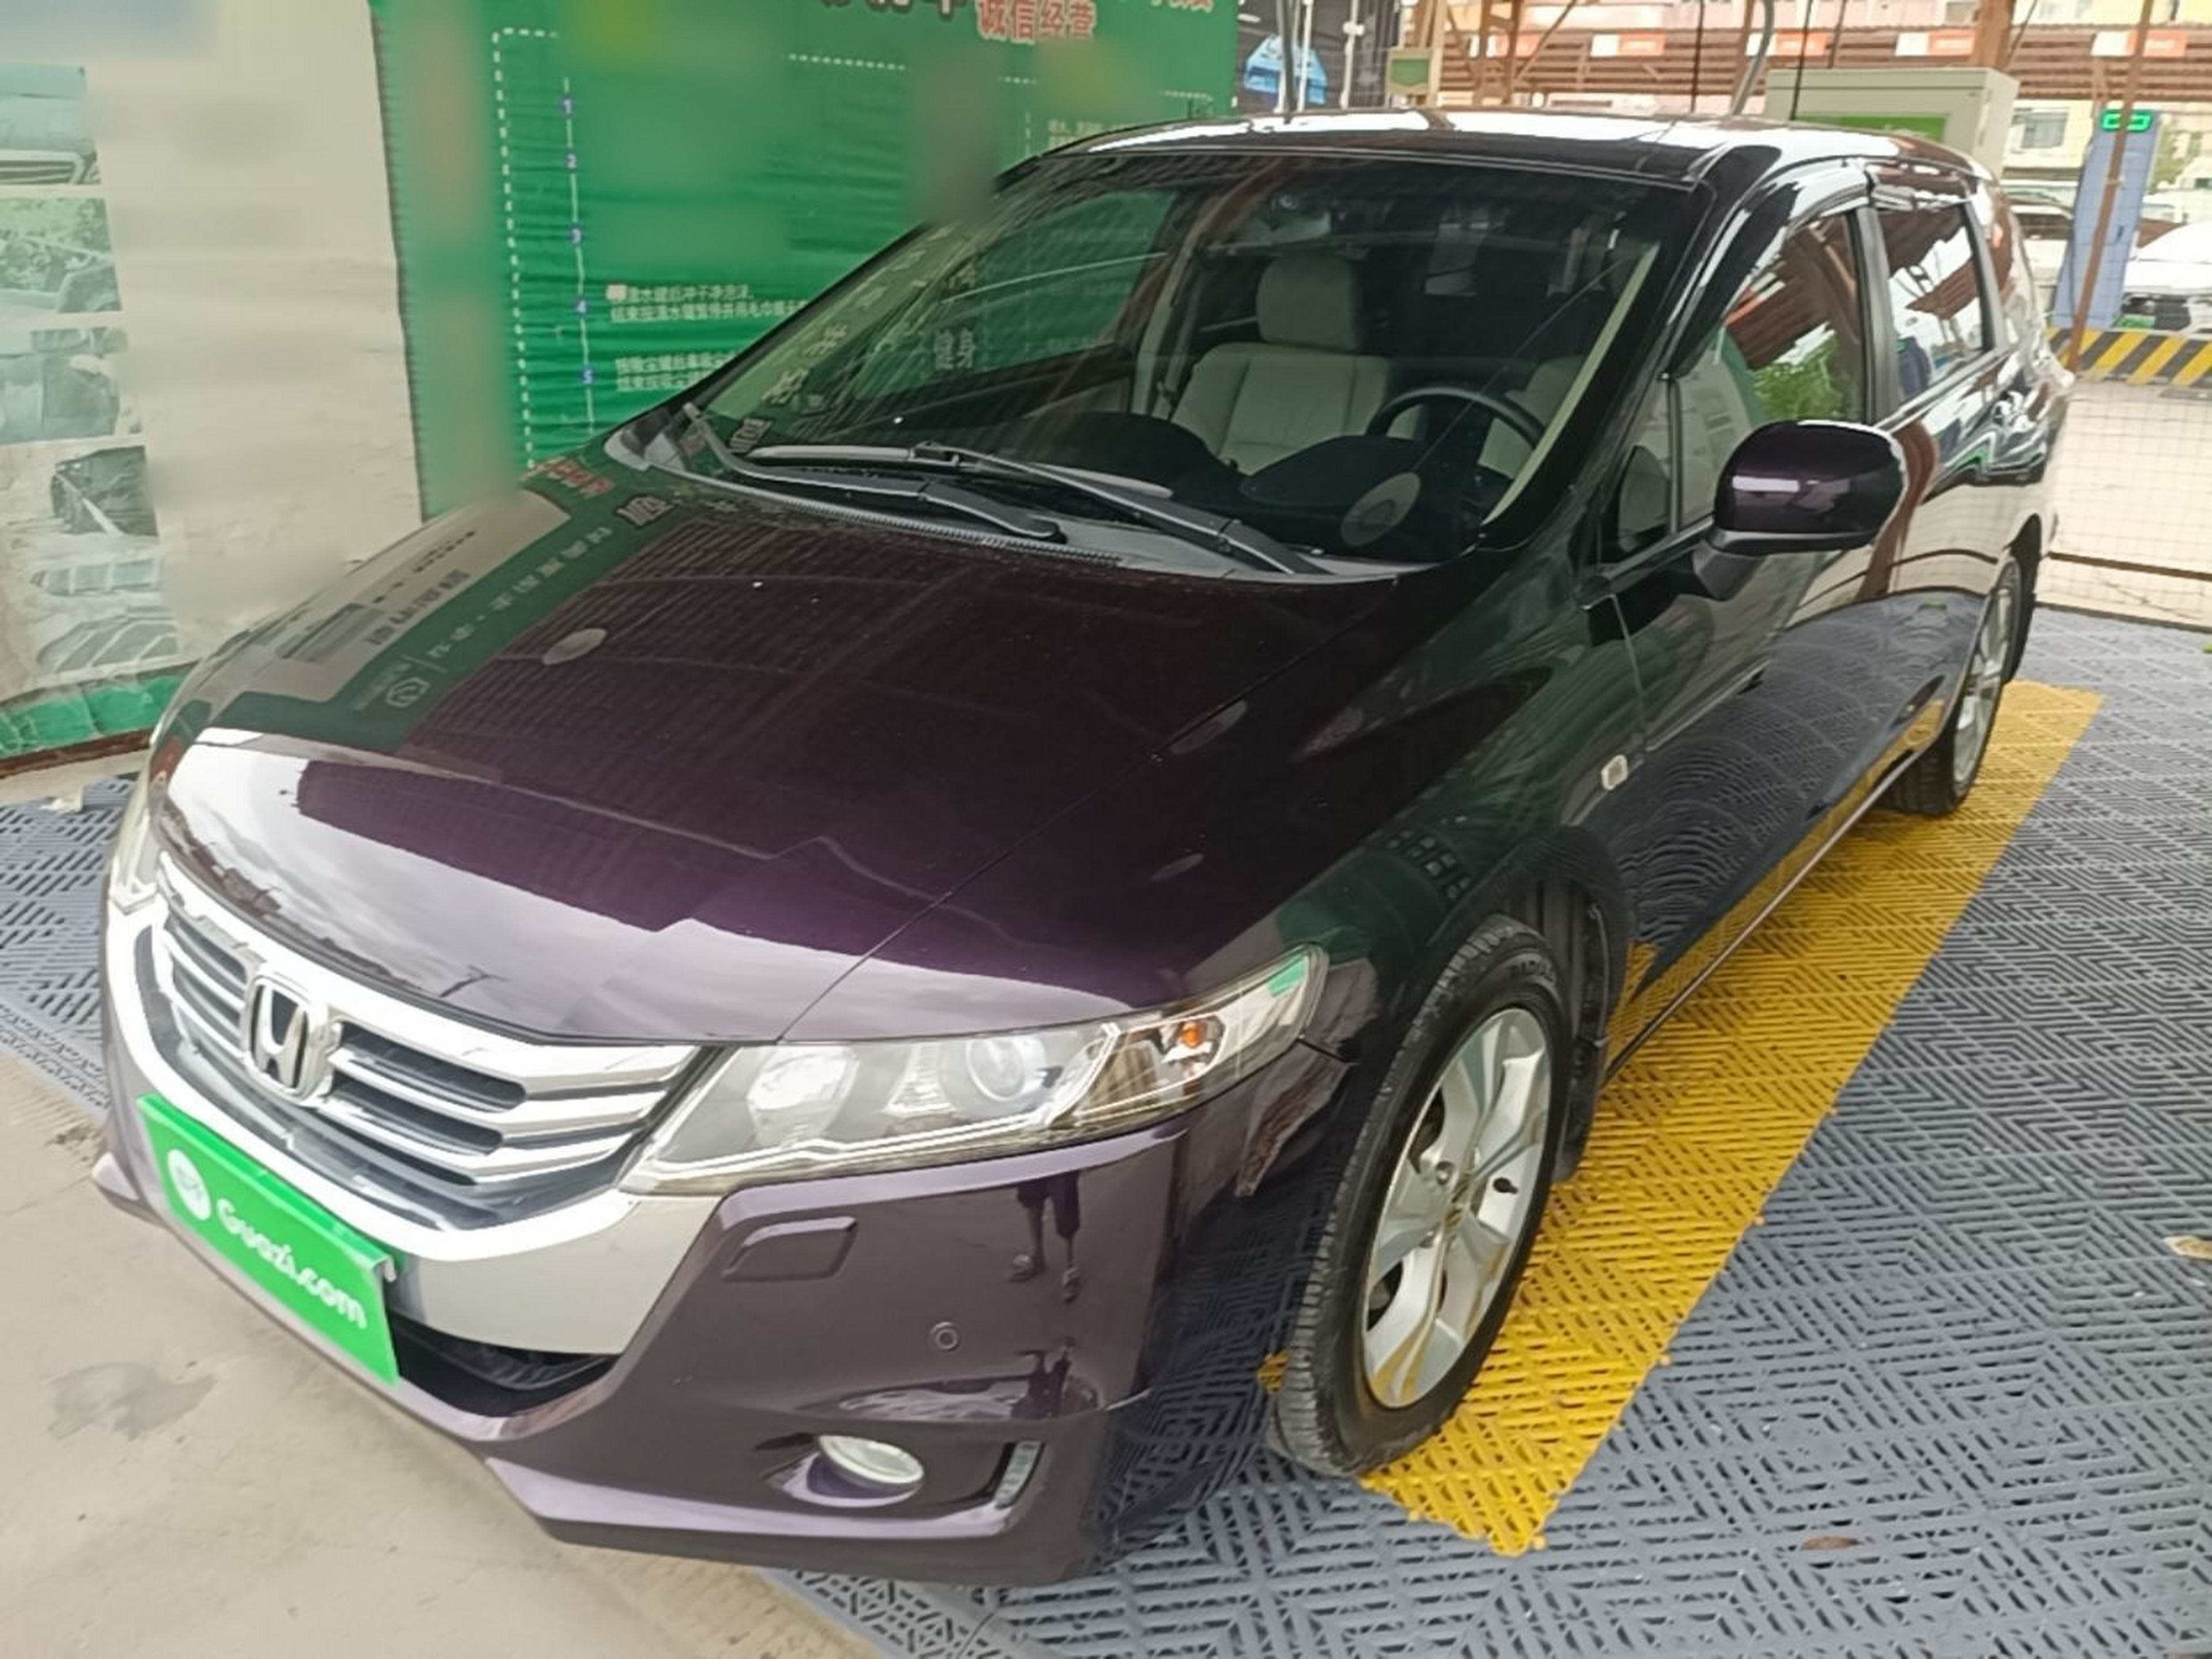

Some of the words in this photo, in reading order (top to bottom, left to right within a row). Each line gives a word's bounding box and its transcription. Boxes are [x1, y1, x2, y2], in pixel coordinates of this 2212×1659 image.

[978, 0, 1095, 43] 诚信经营
[217, 1198, 366, 1329] Guazi.com
